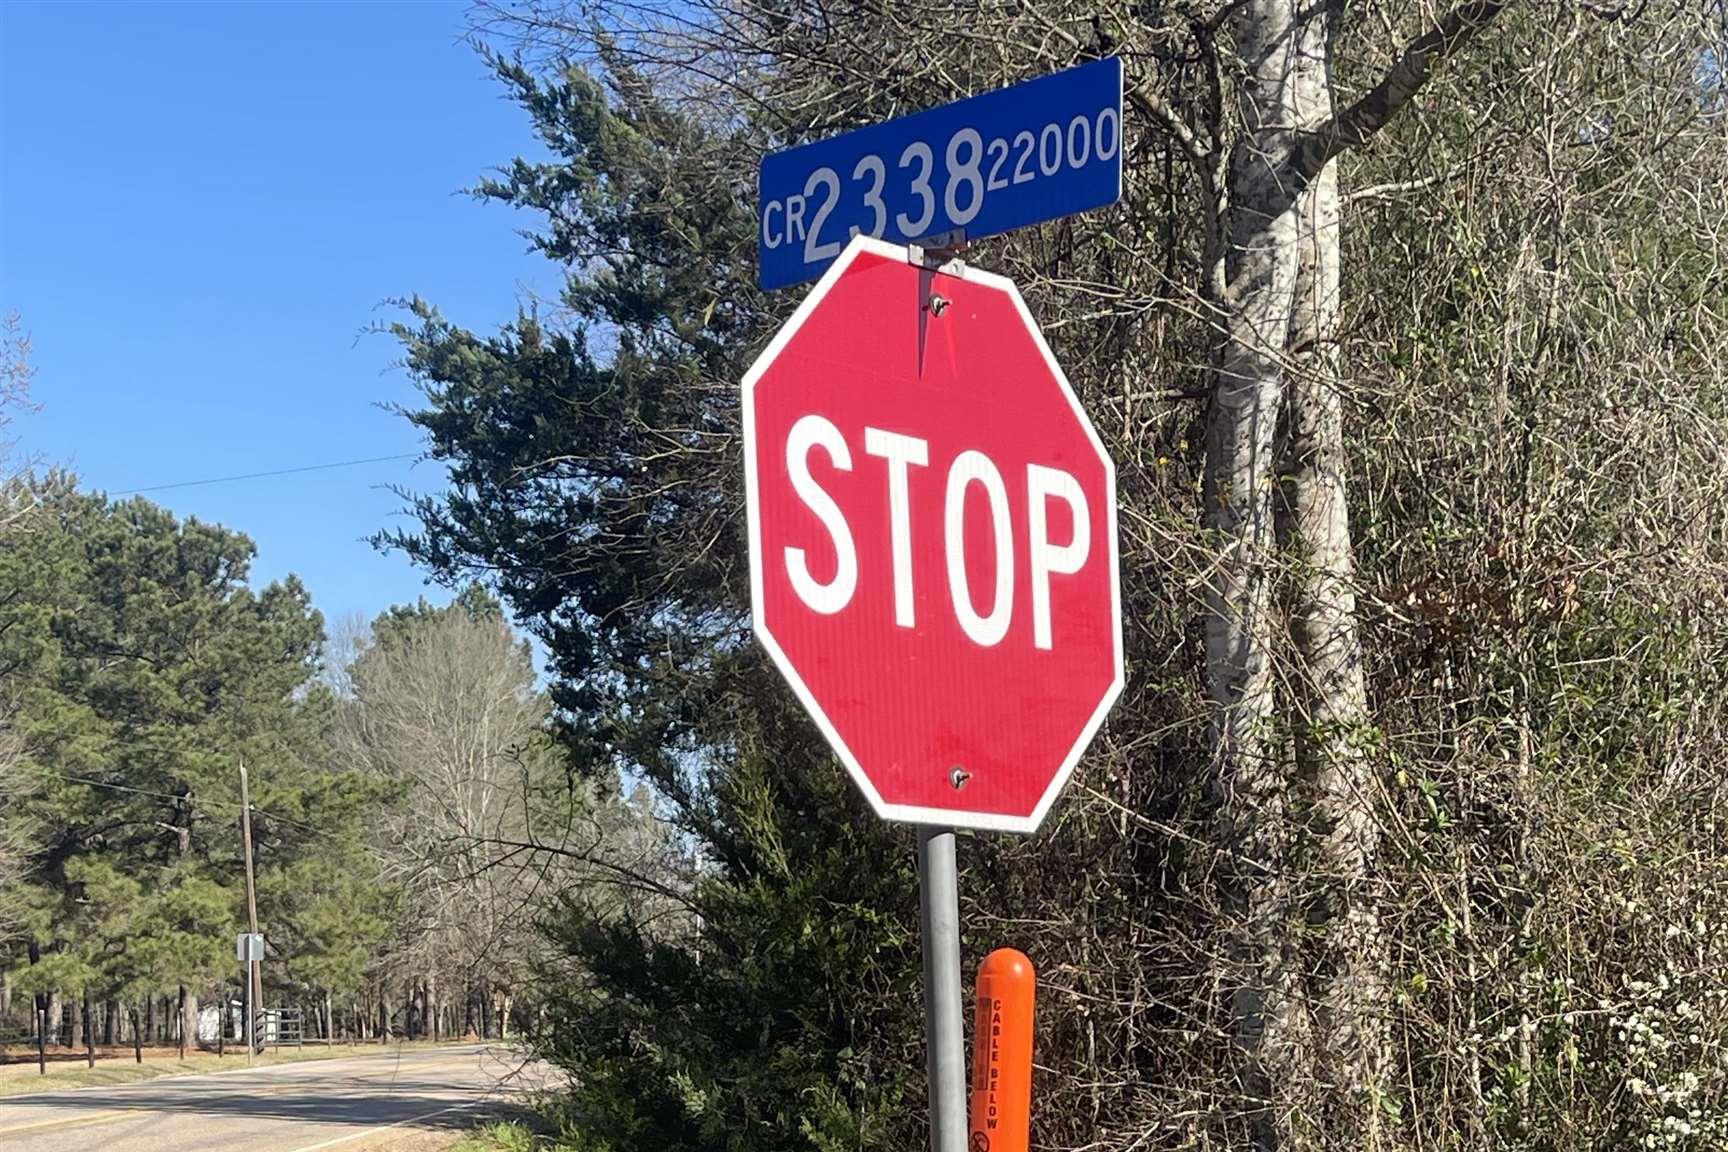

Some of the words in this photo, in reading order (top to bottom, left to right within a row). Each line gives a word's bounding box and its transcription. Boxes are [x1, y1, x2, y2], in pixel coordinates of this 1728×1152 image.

[763, 195, 806, 249] CR
[803, 128, 984, 264] 2338
[986, 108, 1119, 192] 22000
[784, 414, 1092, 651] STOP
[992, 1000, 1001, 1062] CABLE
[987, 1068, 998, 1129] BELOW
